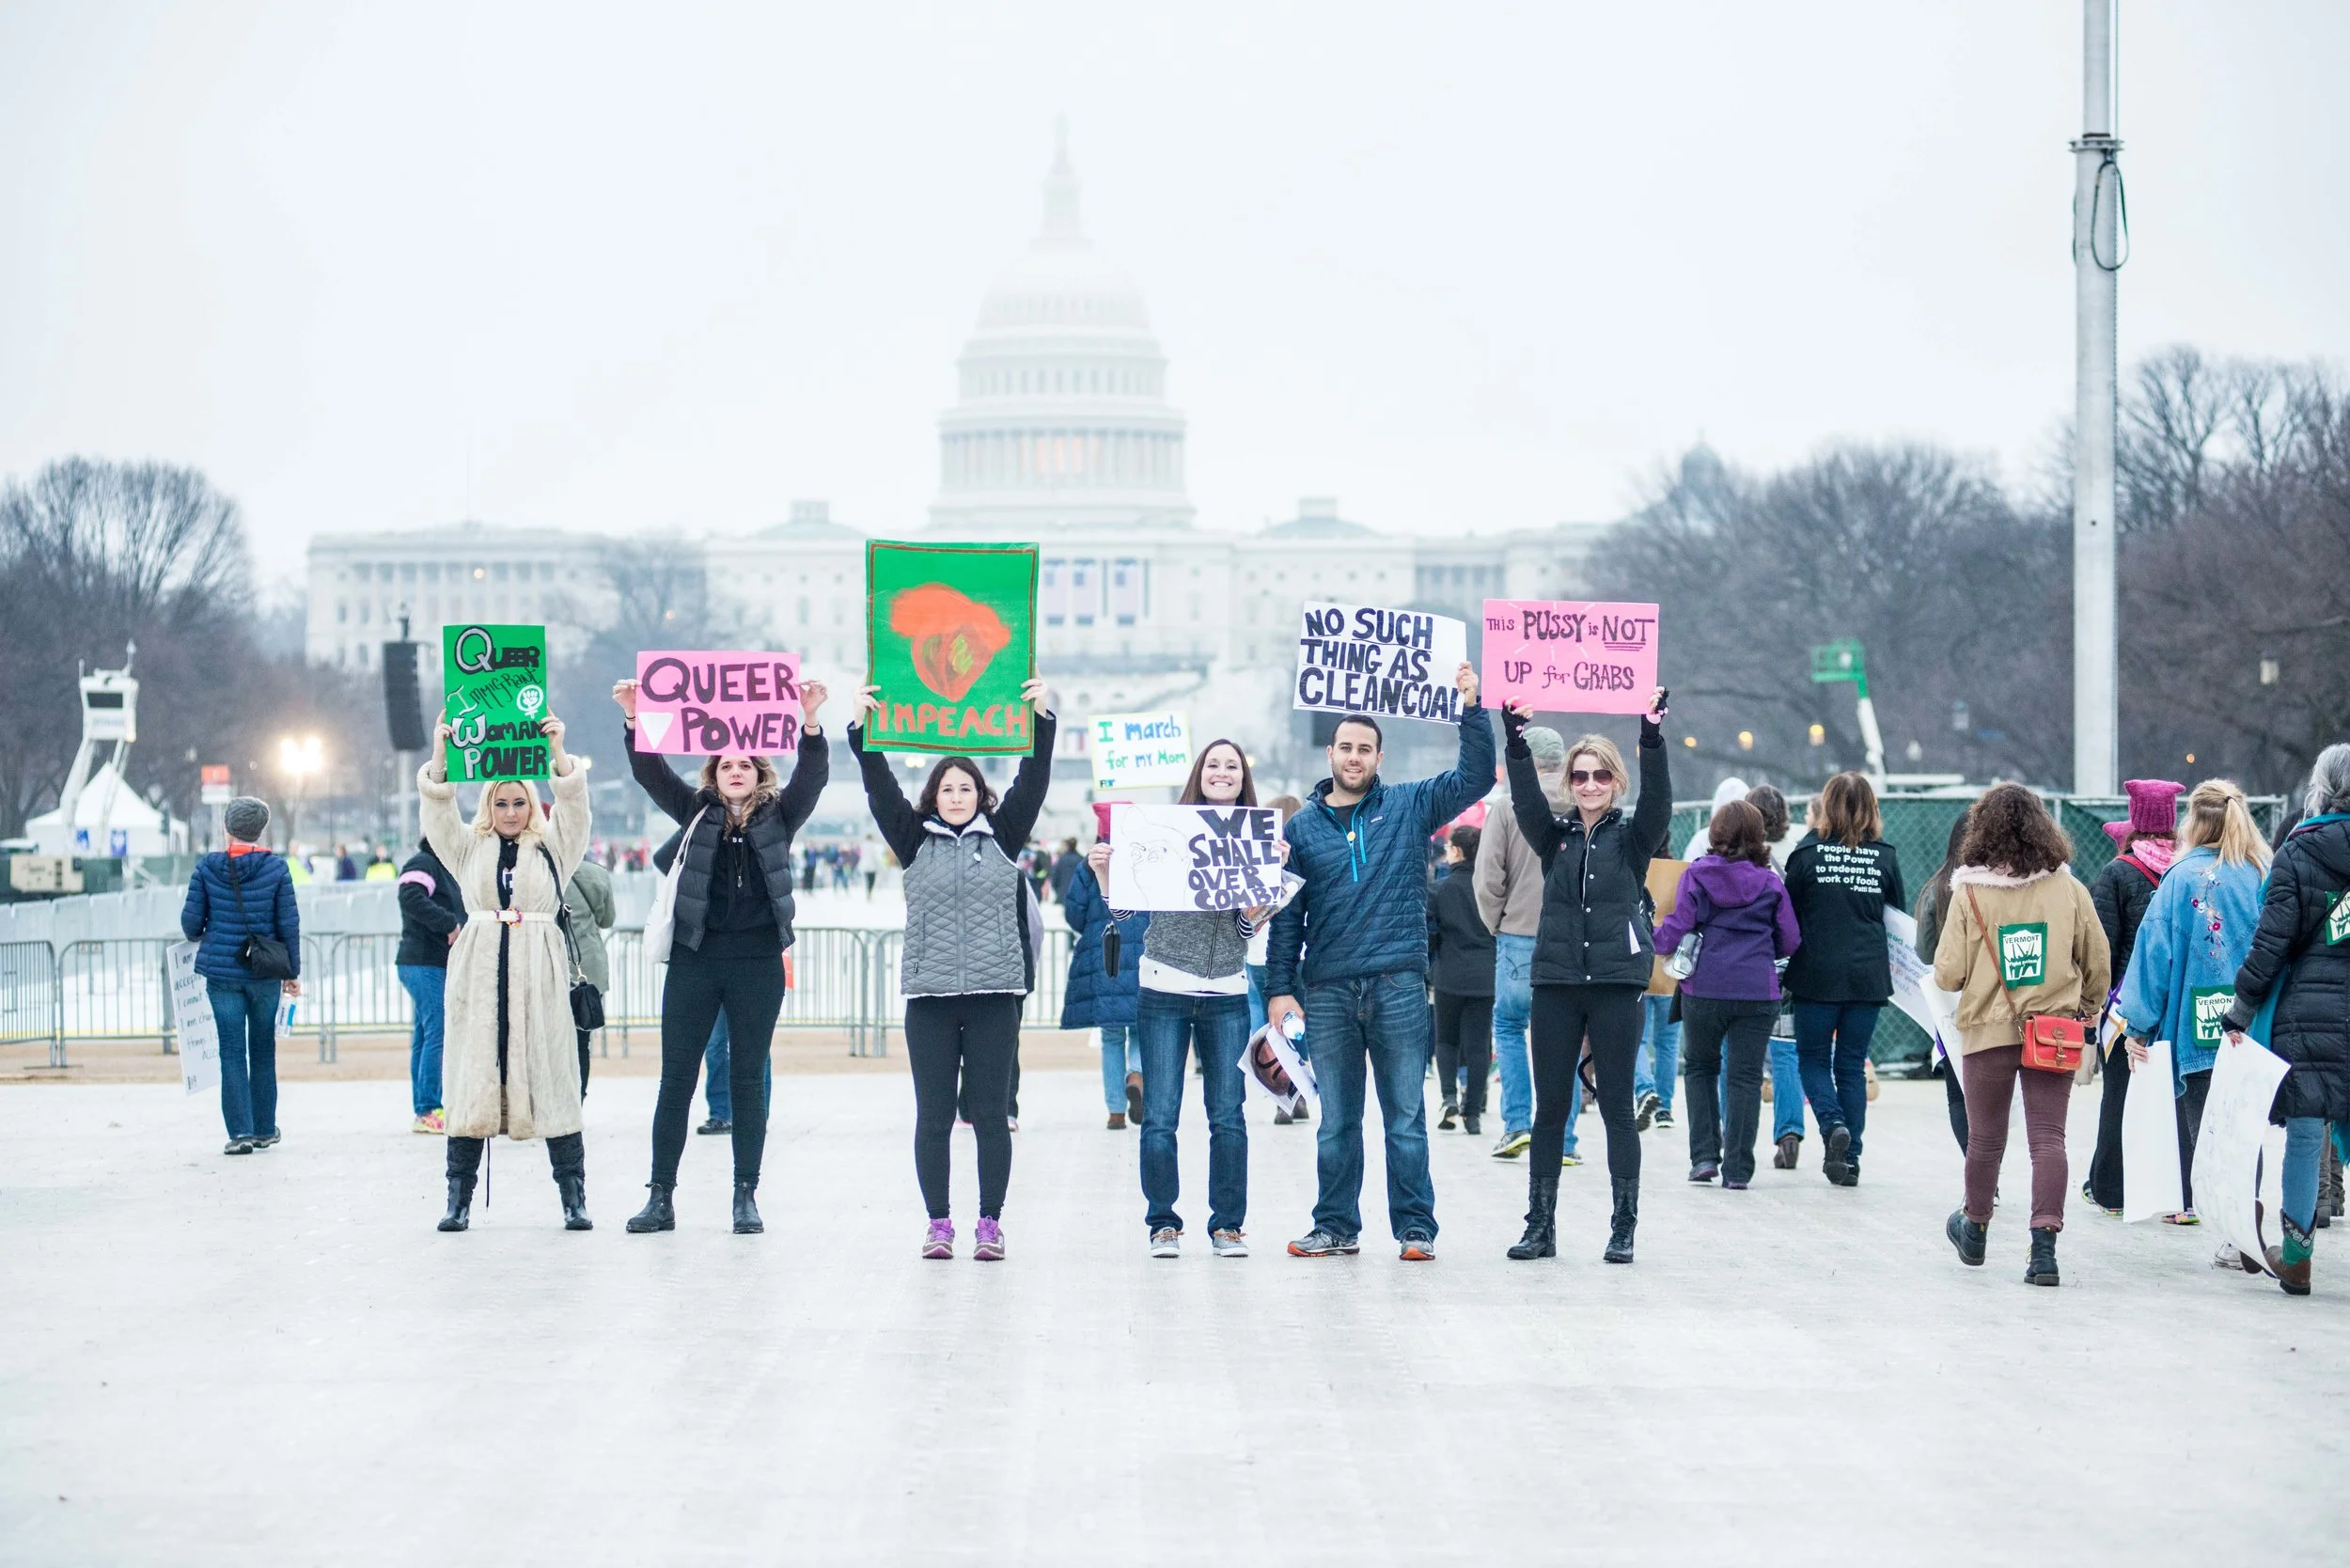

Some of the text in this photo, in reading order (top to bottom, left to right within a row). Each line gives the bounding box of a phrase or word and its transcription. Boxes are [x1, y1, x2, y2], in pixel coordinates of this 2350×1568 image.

[1305, 607, 1434, 650] NO SUCH
[1523, 610, 1587, 643] PUSSY
[1589, 621, 1599, 635] is
[1602, 615, 1655, 642] NOT
[1300, 638, 1432, 683] THING AS
[642, 657, 798, 704] QUEER
[1504, 661, 1635, 691] UP for GRABS
[681, 707, 797, 752] POWER
[877, 700, 1027, 738] IMPEACH
[1098, 714, 1182, 743] I march
[463, 745, 547, 779] POWER
[1105, 750, 1128, 770] for
[1196, 808, 1275, 841] WE
[1188, 833, 1280, 869] SHALL
[1817, 844, 1879, 857] People have
[1825, 854, 1875, 865] the Power
[1188, 865, 1265, 891] OVER
[1815, 865, 1882, 876] to redeem the
[1817, 874, 1879, 886] work of fools
[1194, 886, 1280, 911] COMB!
[2004, 934, 2039, 944] VERMONT
[2198, 997, 2233, 1006] VERMON
